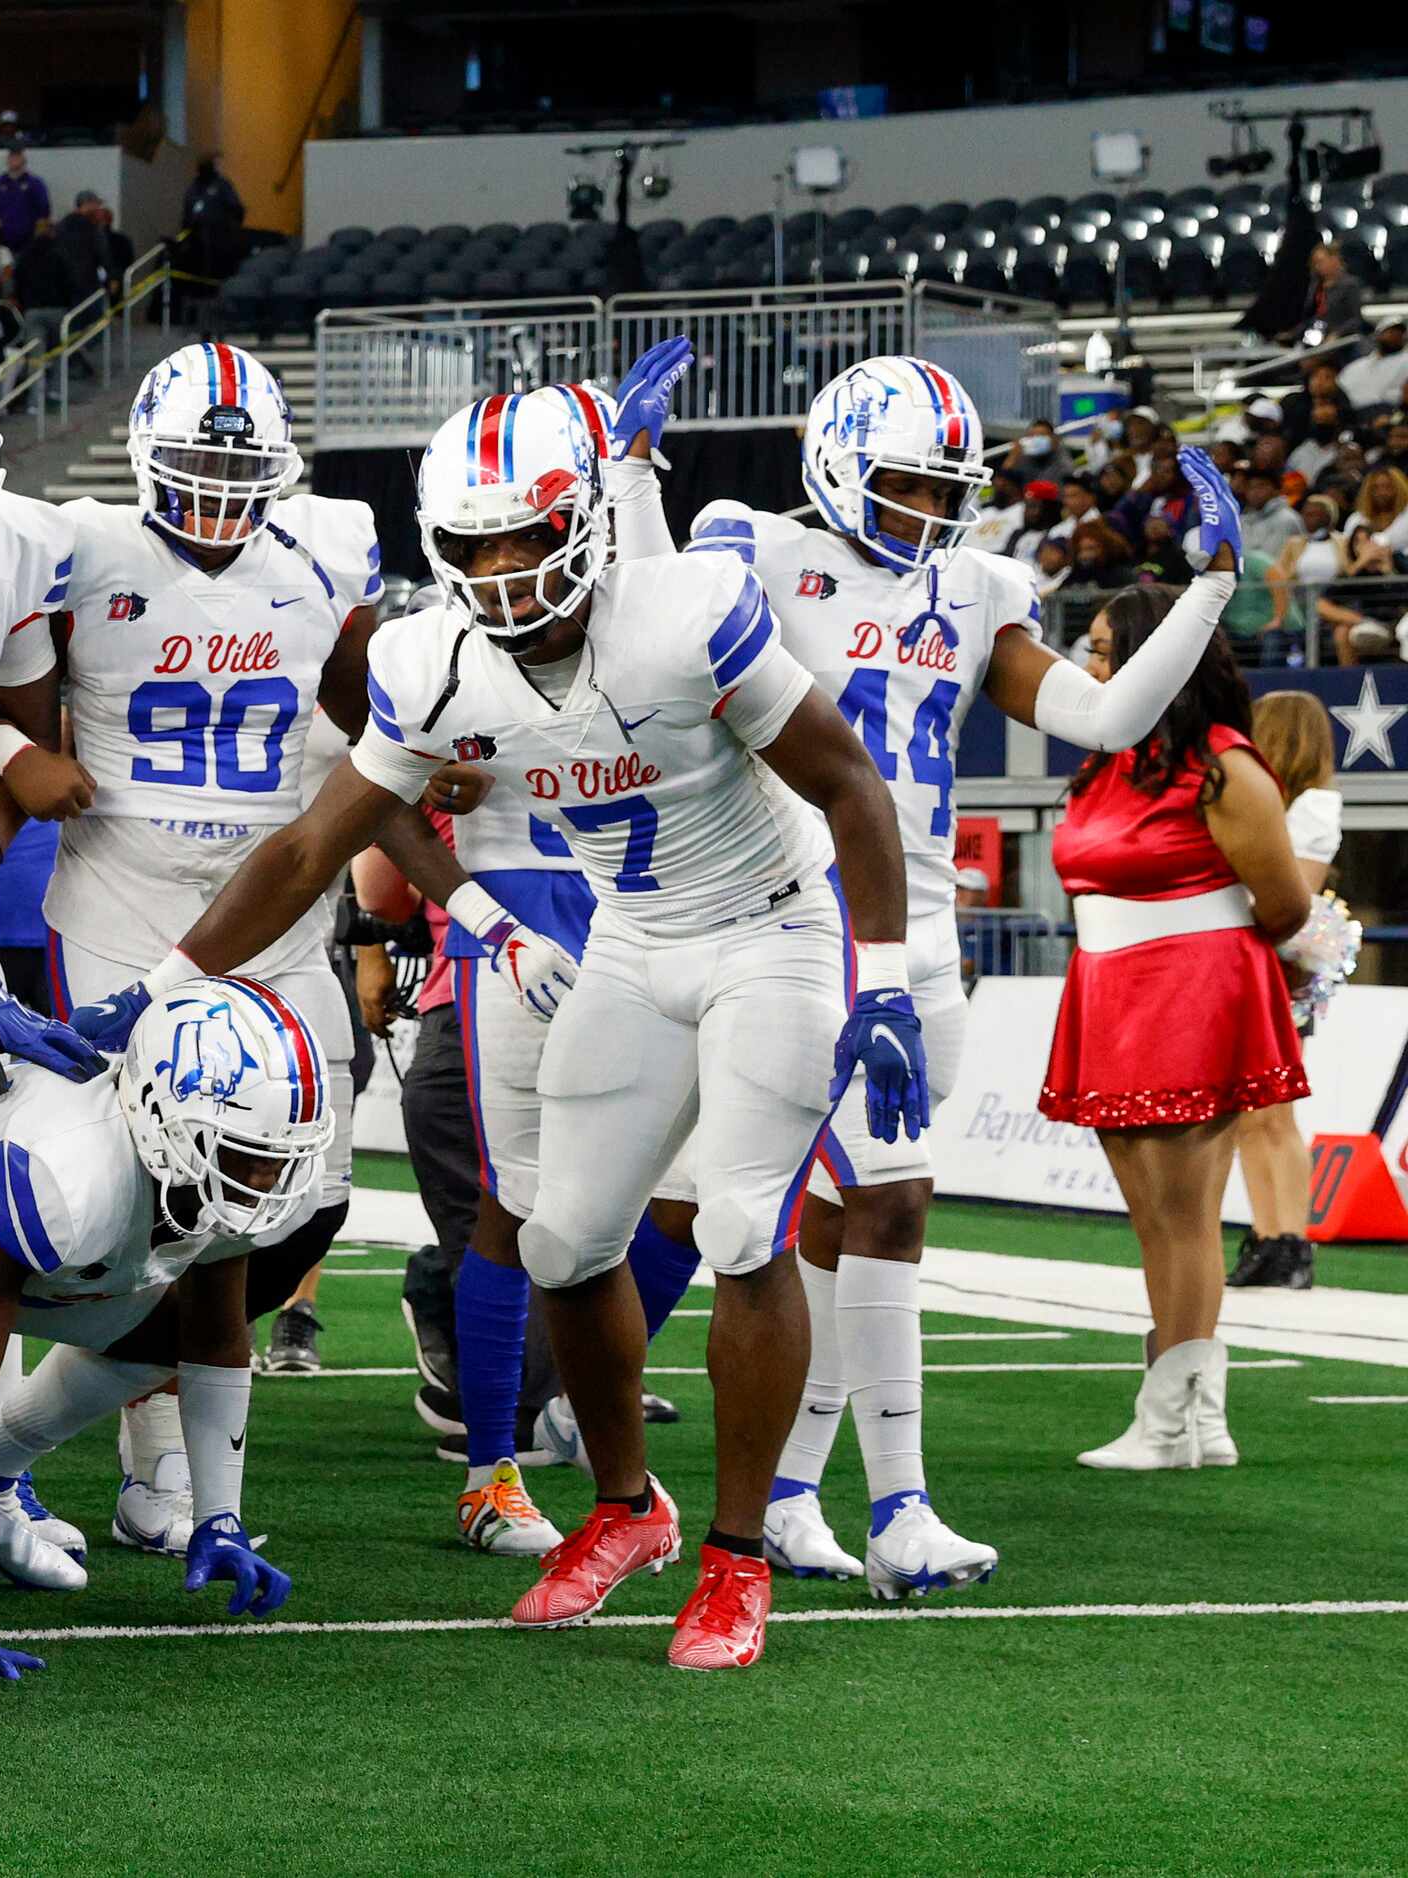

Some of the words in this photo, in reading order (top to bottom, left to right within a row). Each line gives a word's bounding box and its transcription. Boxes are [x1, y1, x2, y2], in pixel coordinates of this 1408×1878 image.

[153, 631, 280, 674] D'Ville
[127, 676, 299, 793] 90
[525, 751, 661, 800] D'Ville
[837, 667, 961, 837] 44
[559, 793, 662, 893] 7
